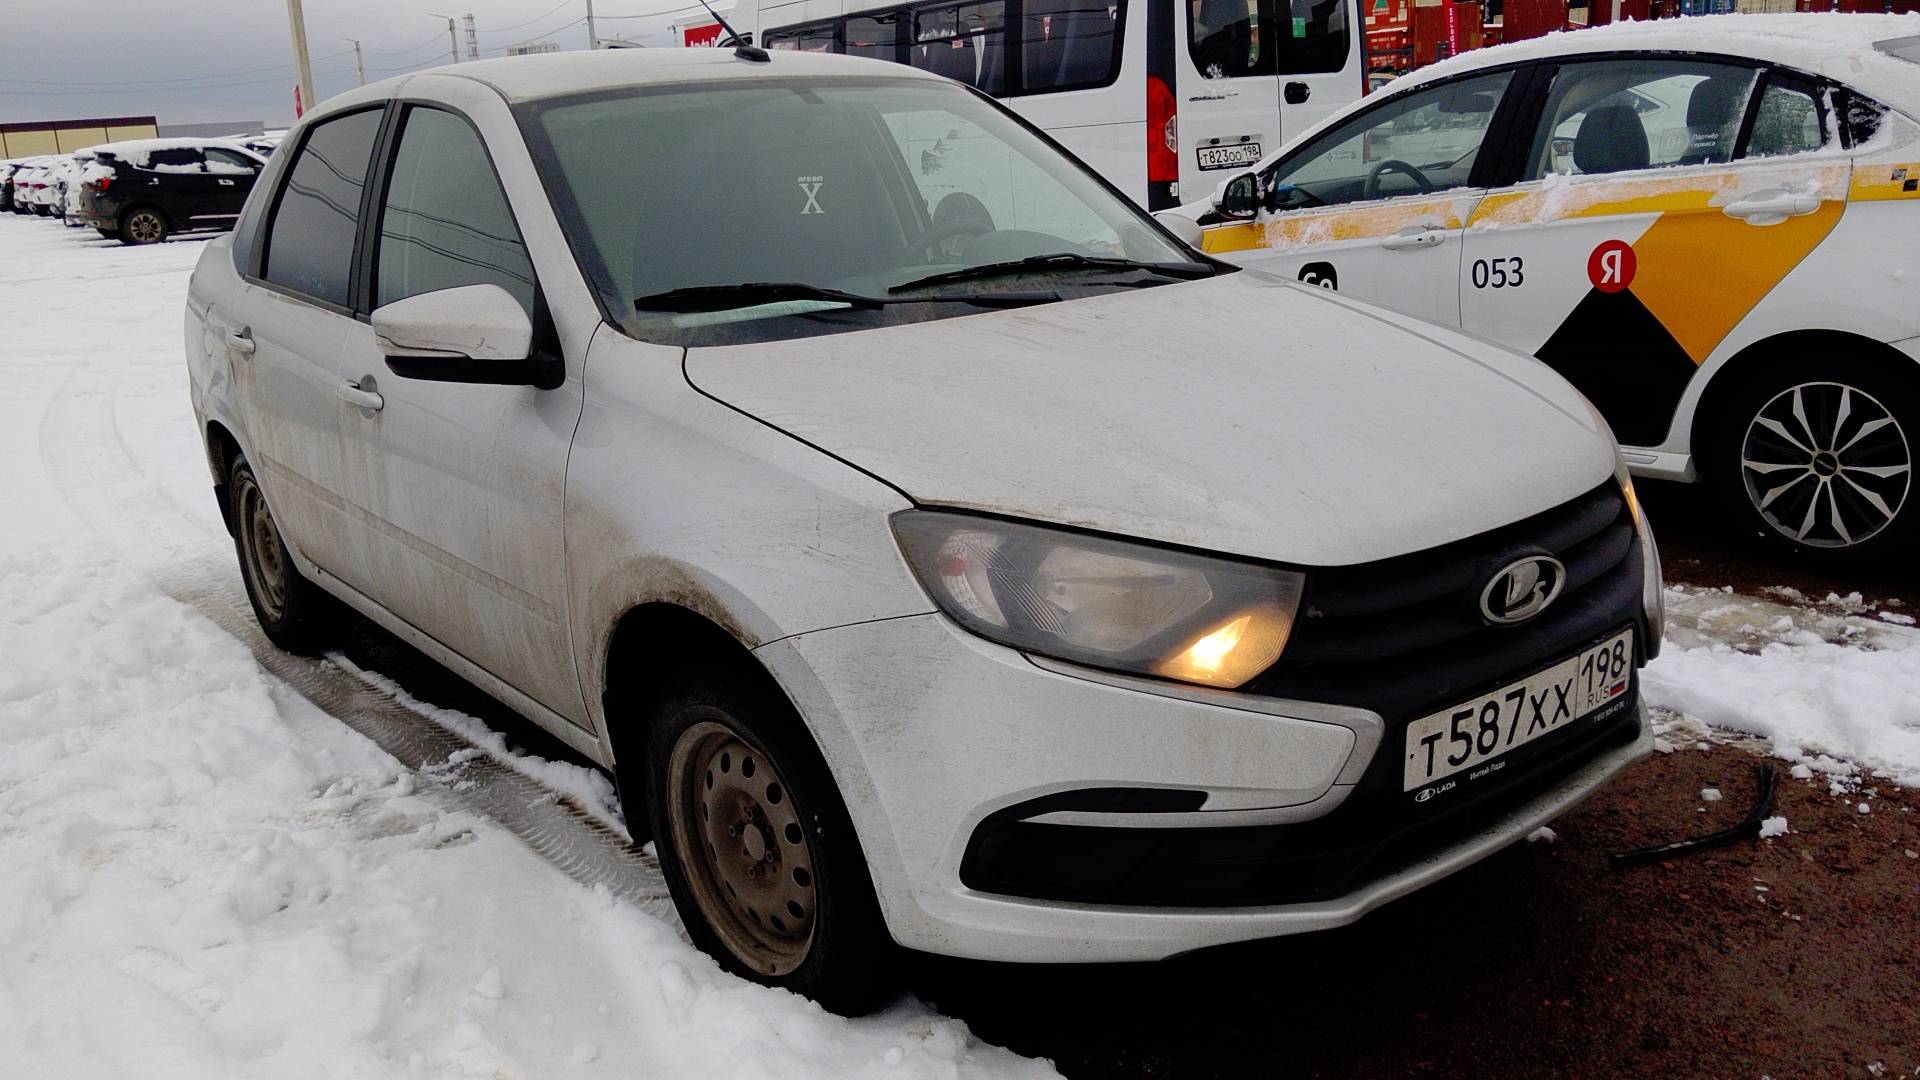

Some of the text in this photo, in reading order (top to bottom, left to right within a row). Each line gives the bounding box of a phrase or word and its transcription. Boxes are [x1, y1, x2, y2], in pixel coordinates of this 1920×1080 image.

[1242, 145, 1257, 157] 198
[798, 183, 824, 214] X
[1472, 256, 1524, 290] 053
[1600, 250, 1622, 284] Я
[1581, 639, 1625, 692] 198
[1586, 686, 1610, 708] RUS
[1436, 780, 1457, 794] LADA
